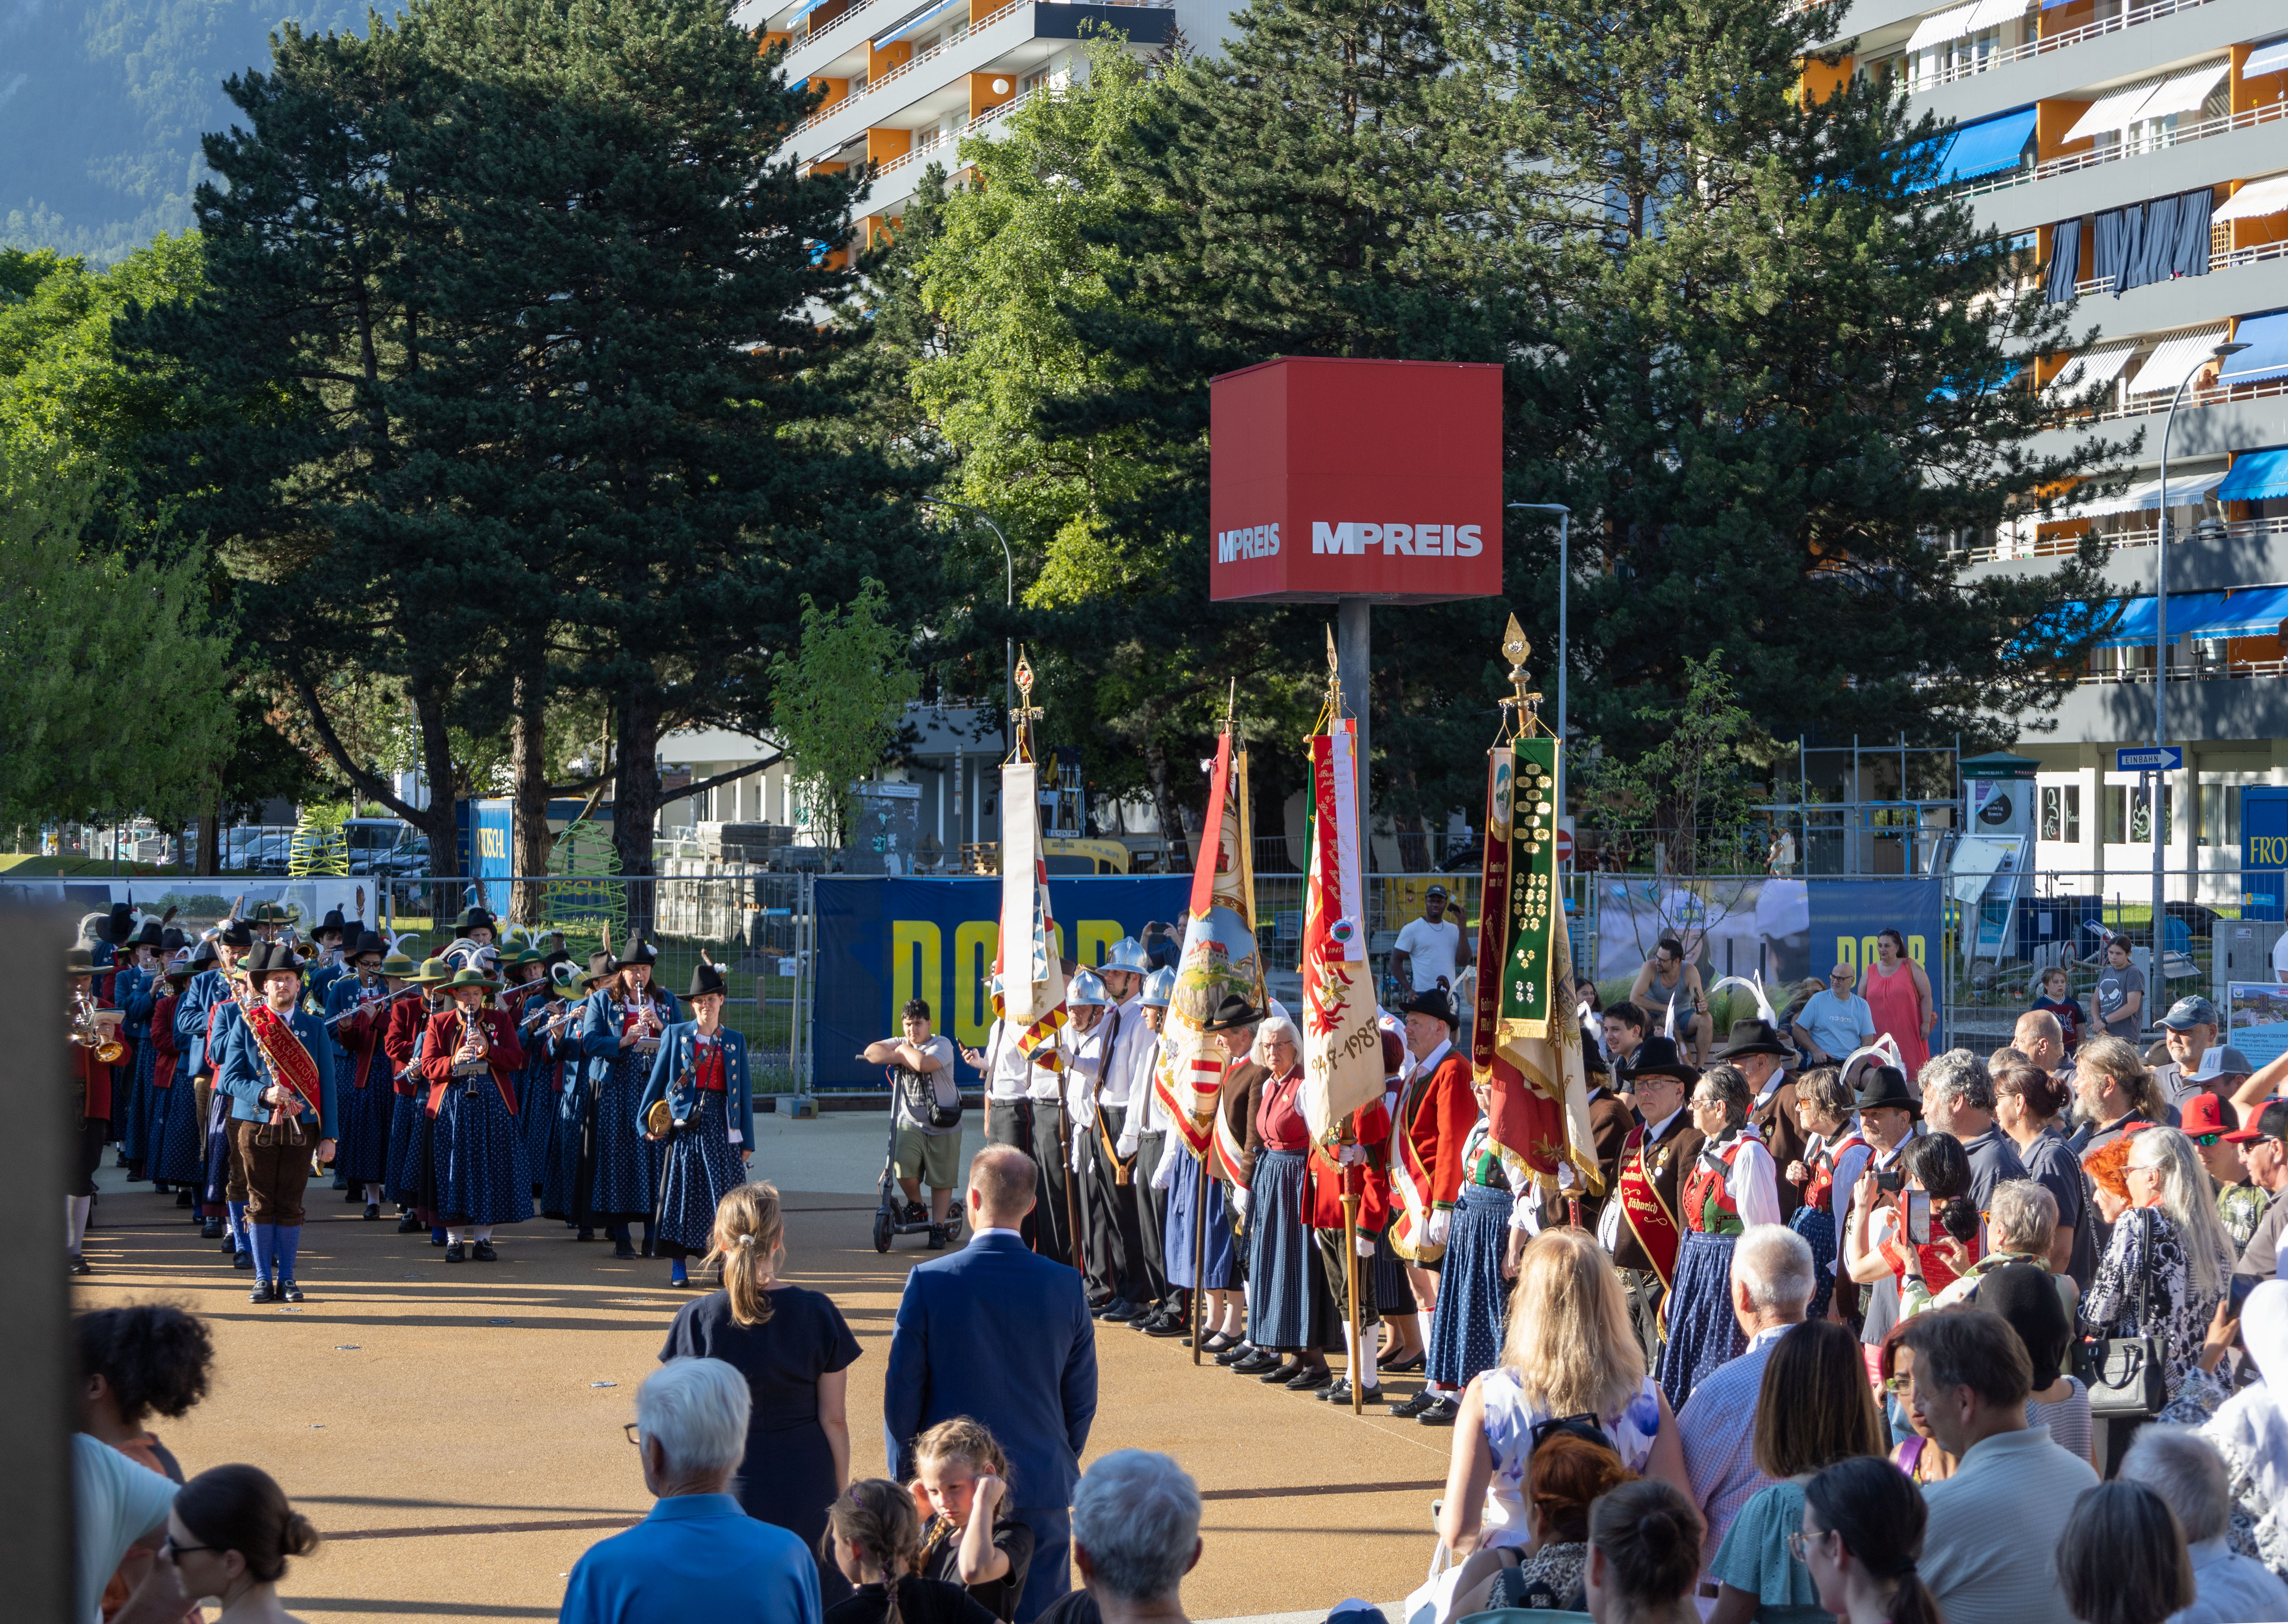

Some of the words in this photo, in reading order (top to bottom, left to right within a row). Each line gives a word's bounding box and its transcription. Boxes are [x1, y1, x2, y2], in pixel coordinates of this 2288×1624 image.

[1219, 523, 1279, 563] MPREIS
[1312, 521, 1482, 556] MPREIS
[1327, 748, 1338, 756] 60
[1321, 758, 1346, 767] jähriges
[2125, 755, 2158, 764] EINBAHN
[1627, 1196, 1658, 1214] Fähnrich
